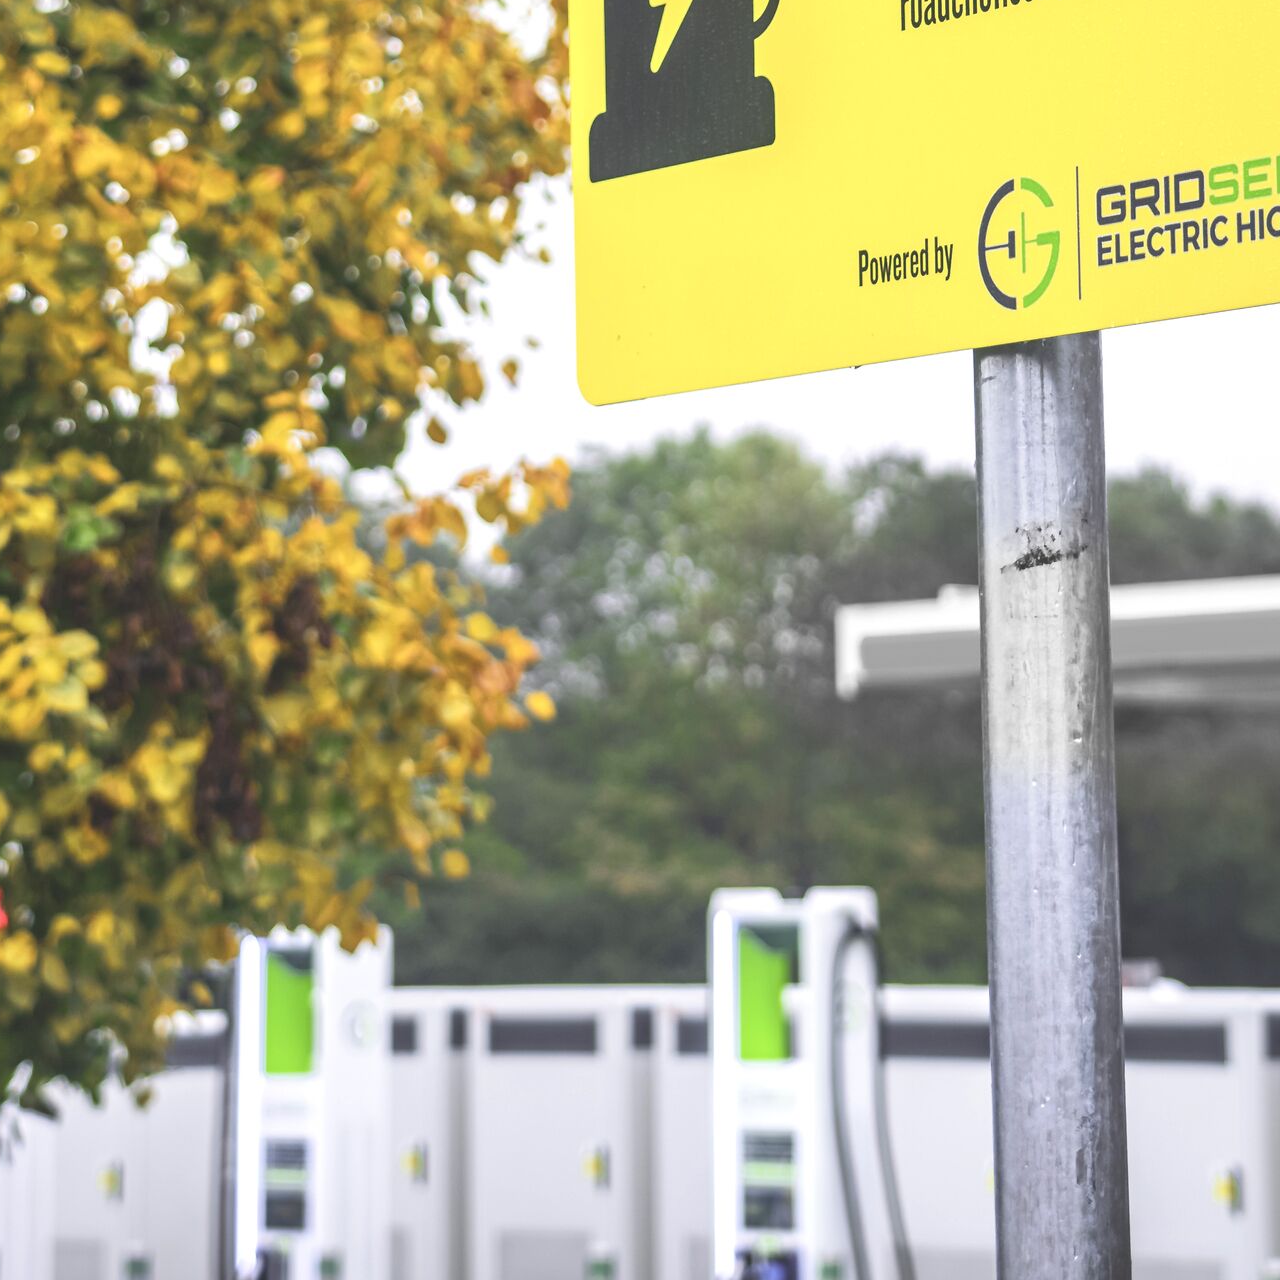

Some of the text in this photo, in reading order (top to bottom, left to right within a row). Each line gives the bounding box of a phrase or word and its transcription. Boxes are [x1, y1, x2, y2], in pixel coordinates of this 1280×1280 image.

[858, 236, 954, 286] Powered by
[1097, 214, 1229, 266] ELECTRIC
